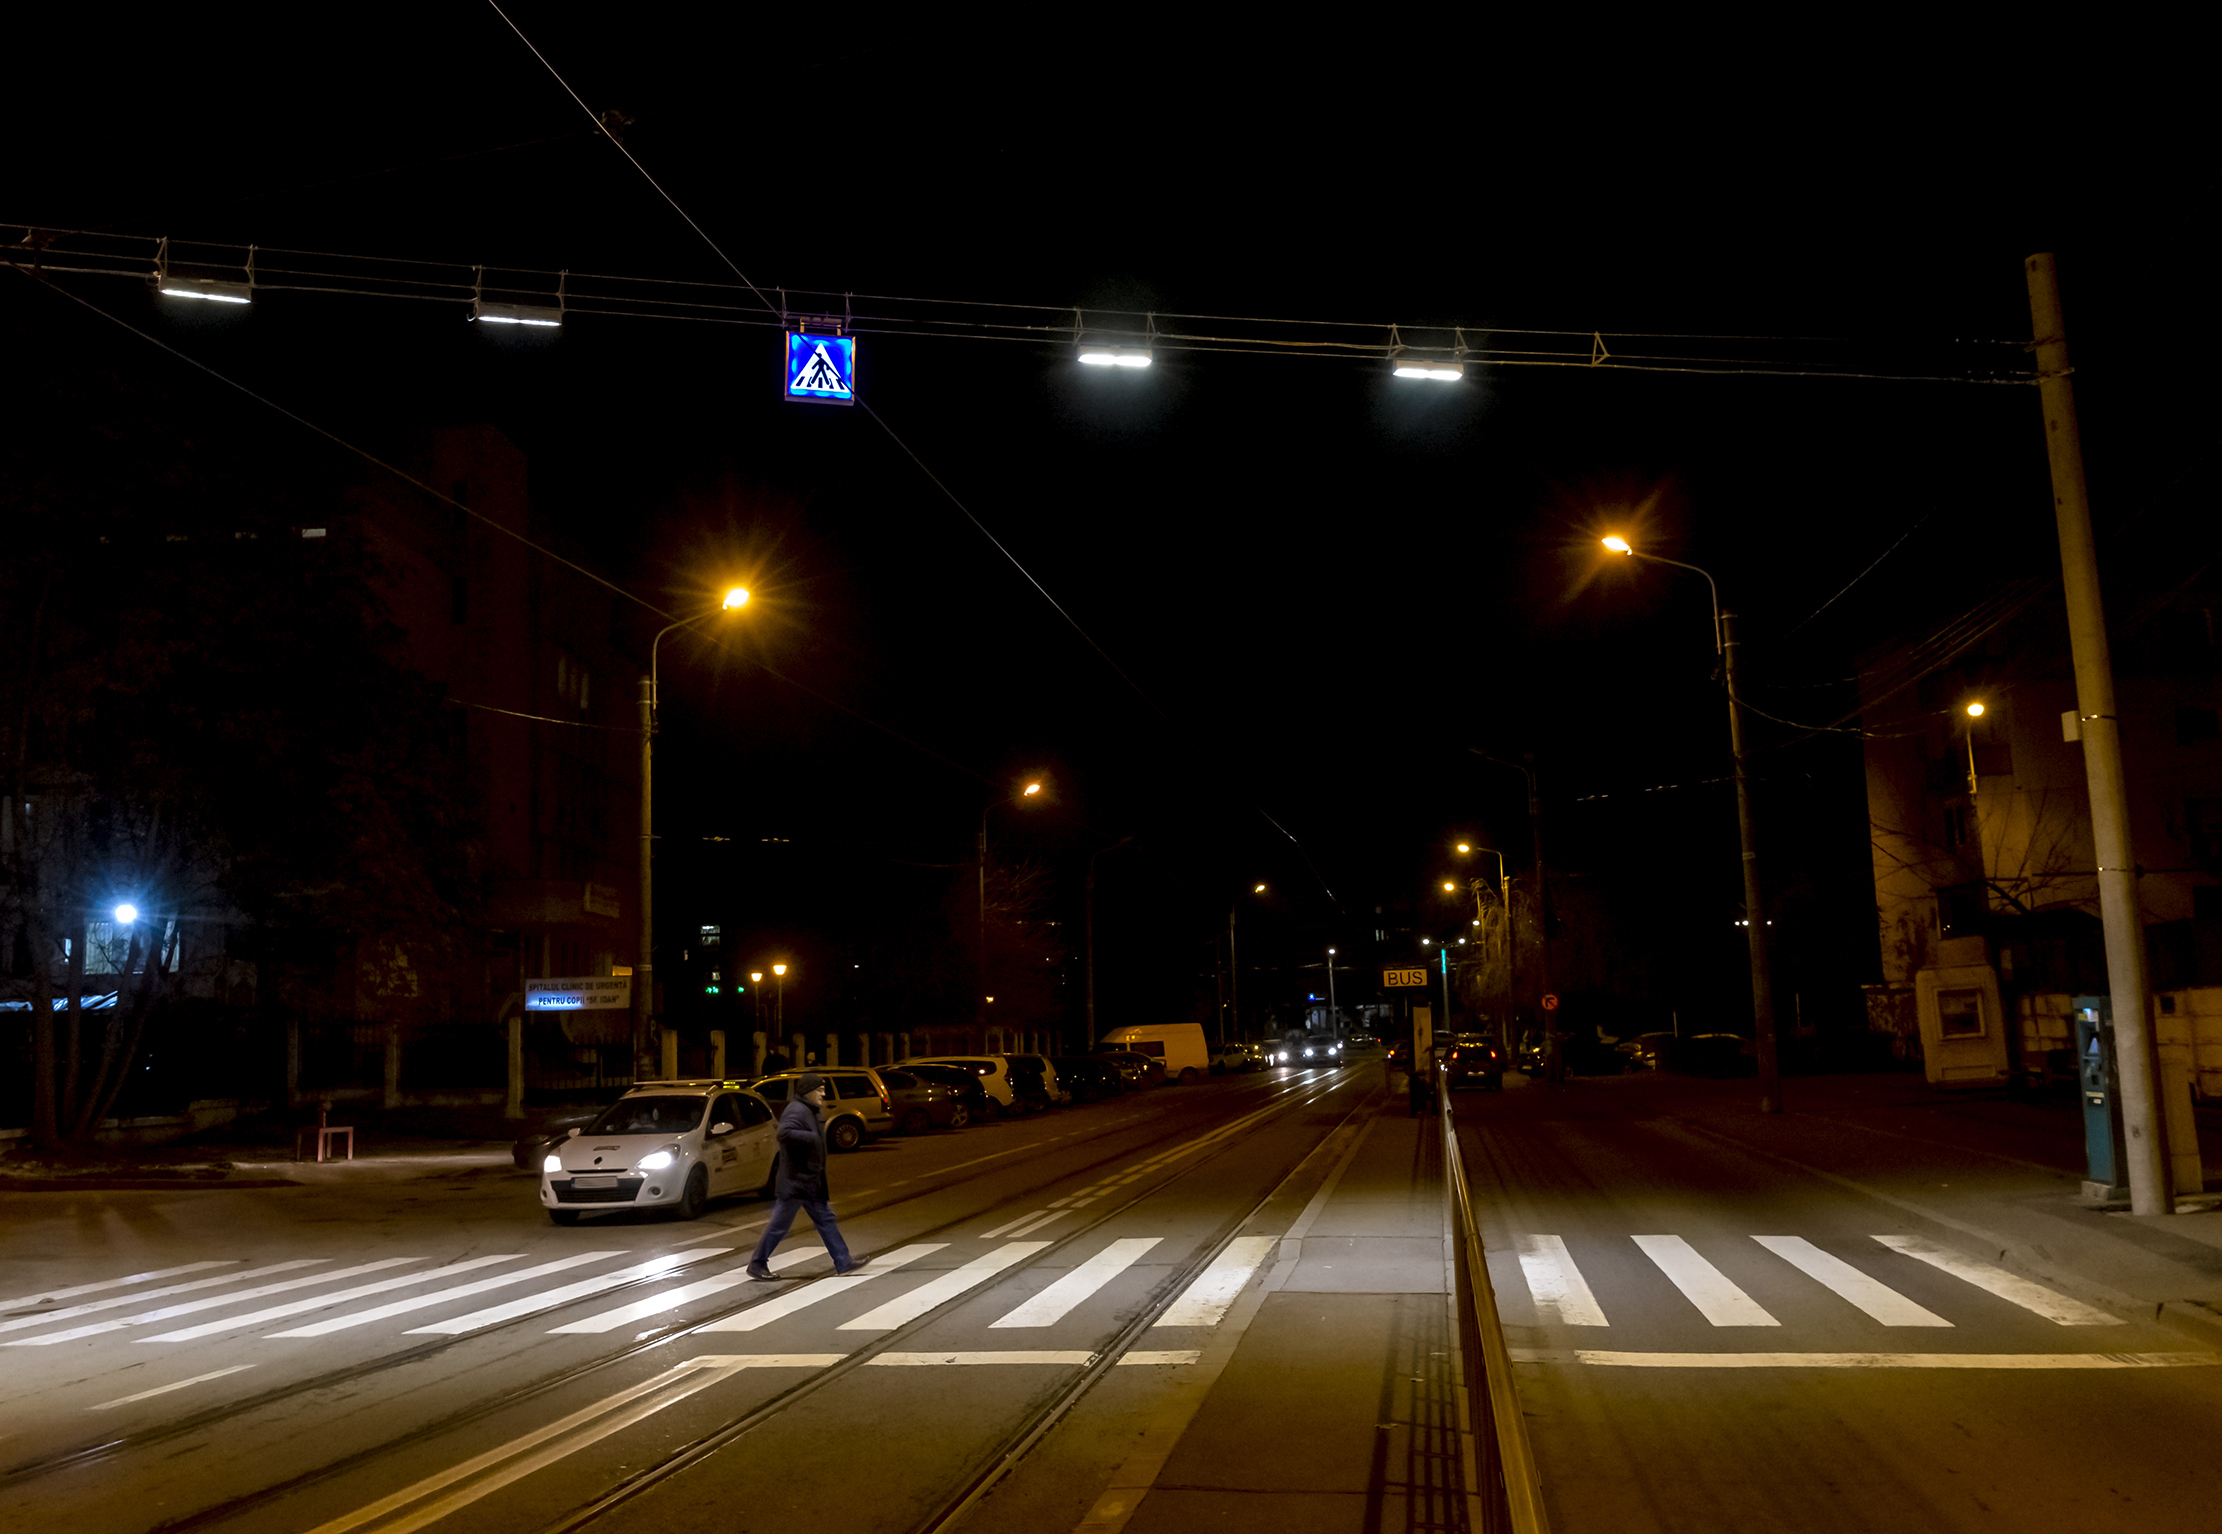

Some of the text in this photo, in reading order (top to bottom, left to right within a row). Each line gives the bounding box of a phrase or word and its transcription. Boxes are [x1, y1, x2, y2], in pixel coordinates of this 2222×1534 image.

[1388, 971, 1423, 985] BUS
[528, 983, 560, 991] SPITALUL
[561, 982, 584, 991] CLINIC
[585, 982, 594, 991] DE
[538, 997, 565, 1005] PENTRU
[566, 996, 585, 1005] COPII
